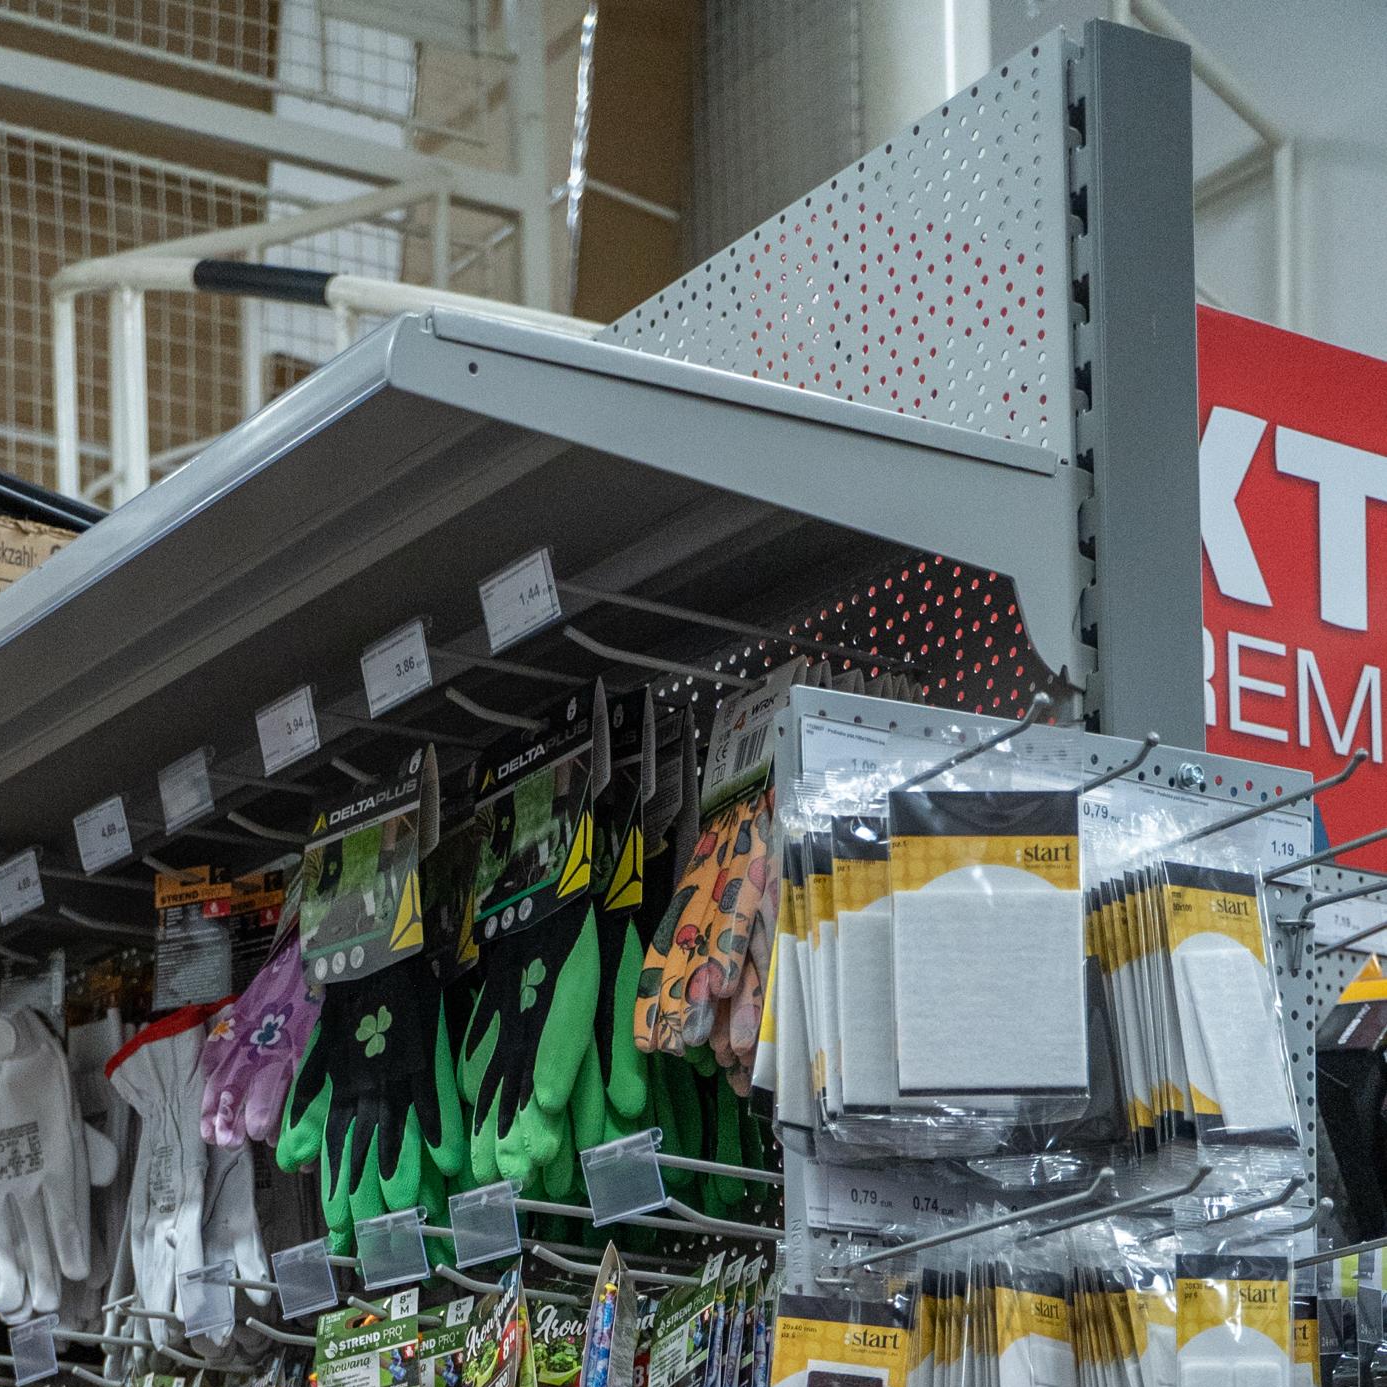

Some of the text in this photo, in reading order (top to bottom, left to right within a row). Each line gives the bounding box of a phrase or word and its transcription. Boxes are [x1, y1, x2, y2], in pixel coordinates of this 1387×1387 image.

[518, 585, 542, 608] 1,44
[395, 657, 416, 680] 3,86
[498, 719, 590, 781] DELTAPLUS
[329, 778, 418, 826] DELTAPLUS
[1083, 803, 1109, 820] 0,79
[1023, 842, 1073, 863] start
[1271, 840, 1295, 857] 1,19
[1216, 897, 1250, 917] start
[850, 1187, 878, 1205] 0,79
[913, 1195, 940, 1213] 0,74
[1239, 1283, 1279, 1304] start
[399, 1305, 410, 1316] M
[455, 1313, 465, 1322] M
[666, 1303, 693, 1329] STREND
[1034, 1299, 1059, 1320] start
[339, 1325, 403, 1351] STREND PRO
[852, 1329, 900, 1350] start
